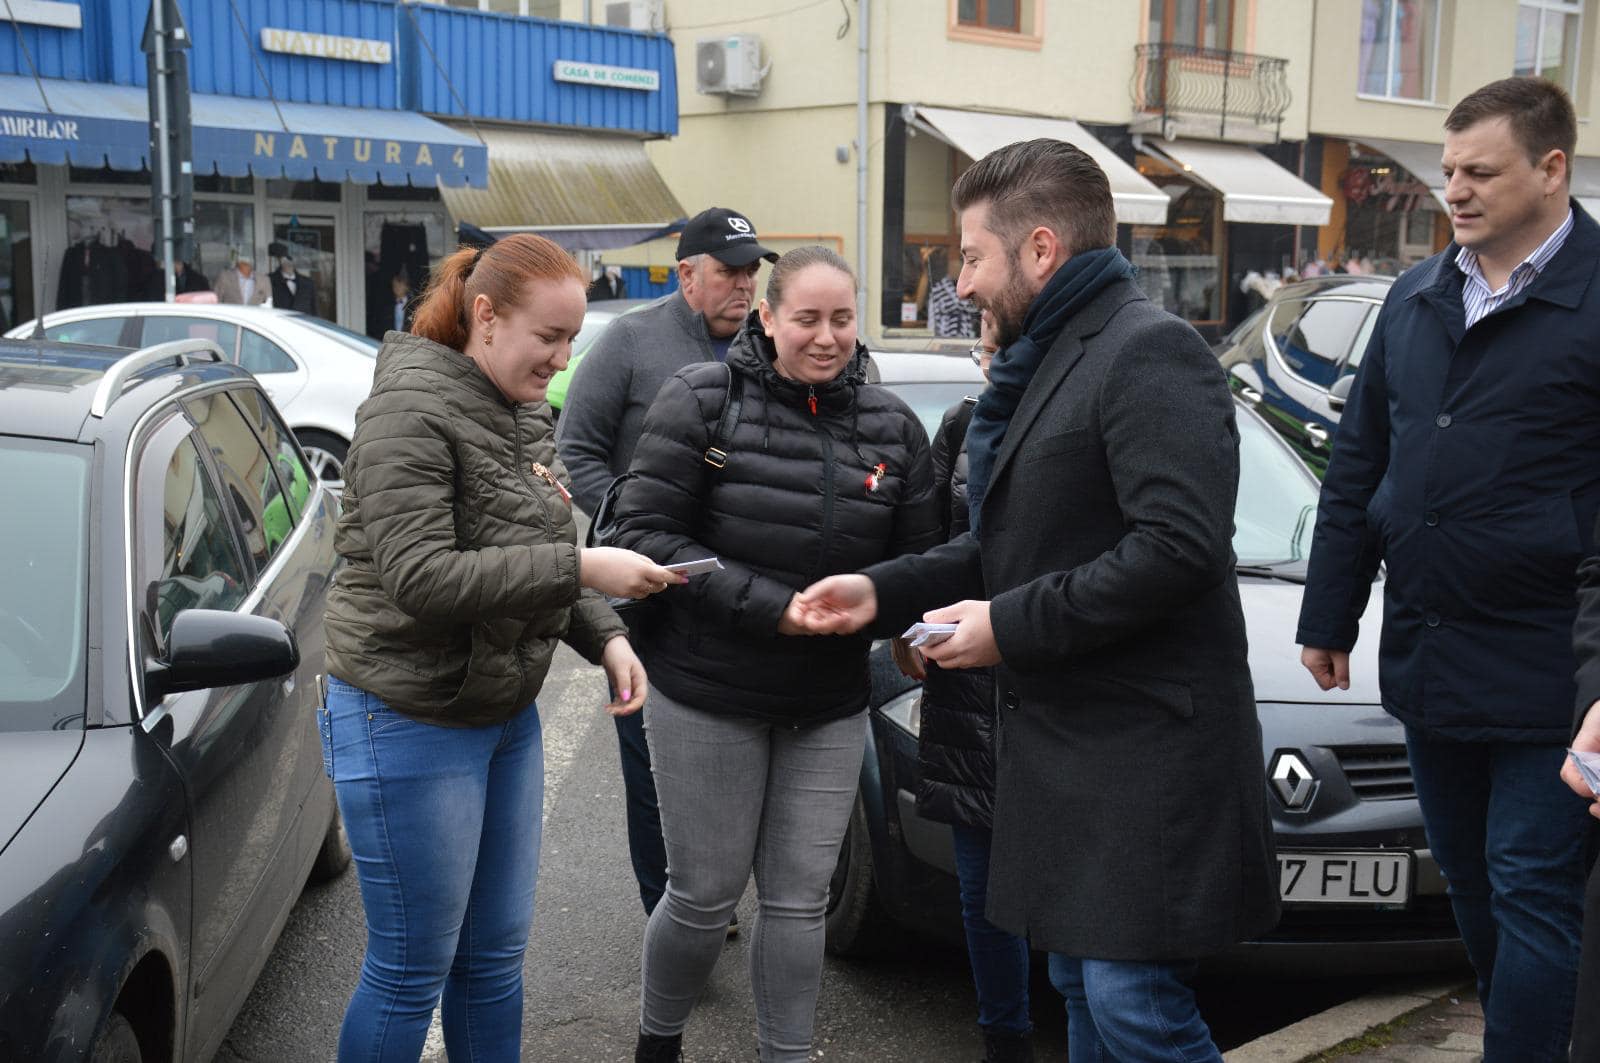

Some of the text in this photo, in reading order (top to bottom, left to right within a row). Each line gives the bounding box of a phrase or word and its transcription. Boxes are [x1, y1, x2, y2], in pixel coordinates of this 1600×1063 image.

[270, 31, 372, 62] NATURA
[563, 66, 589, 77] CASA
[594, 71, 606, 80] DE
[254, 133, 464, 169] NATURA 4
[1280, 859, 1400, 897] 7 FLU
